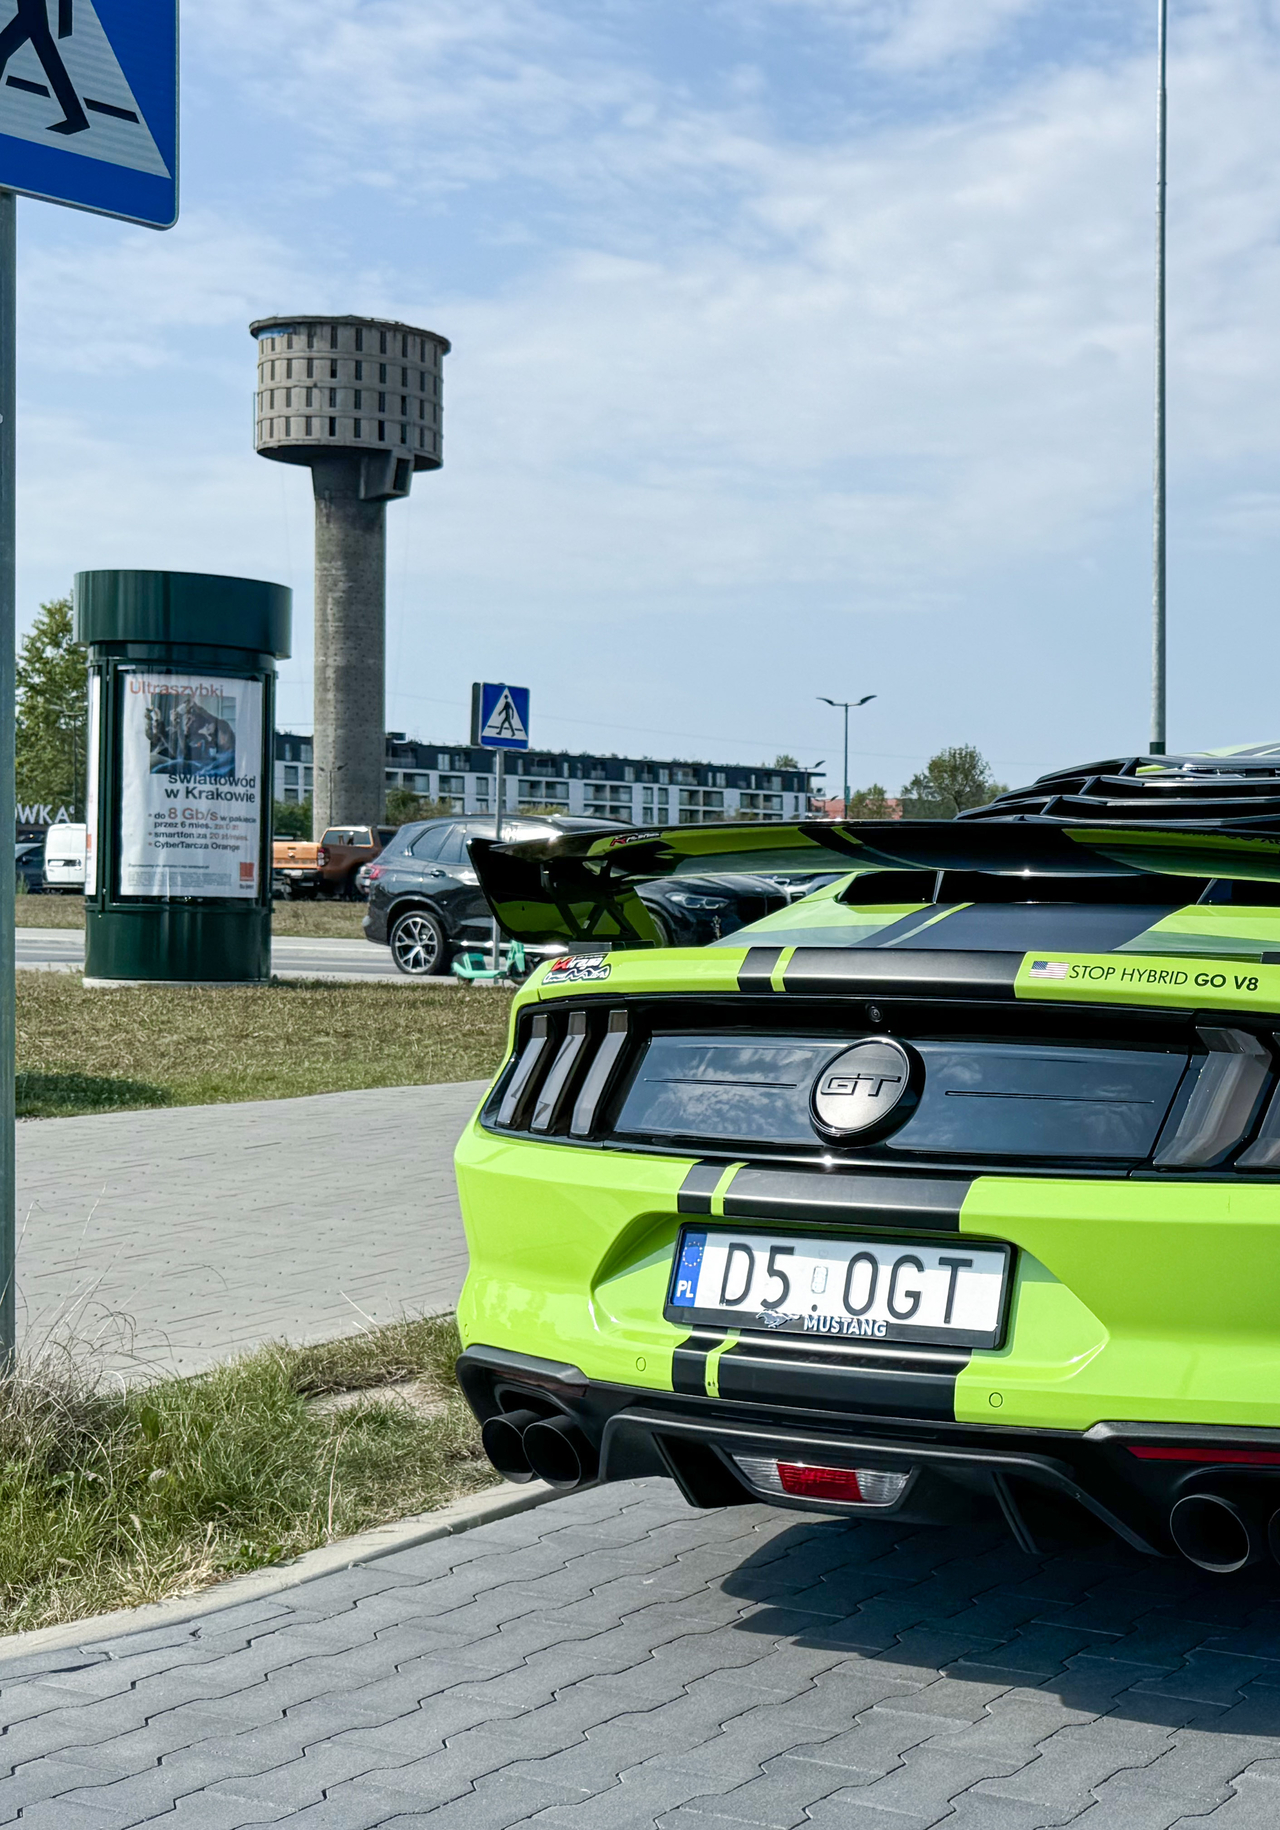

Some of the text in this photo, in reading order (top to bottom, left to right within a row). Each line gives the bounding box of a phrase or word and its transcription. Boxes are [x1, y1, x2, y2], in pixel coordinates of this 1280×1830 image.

[130, 680, 224, 699] Ultraszybki
[164, 786, 255, 803] w Krakowie
[154, 811, 166, 820] do
[168, 807, 178, 820] 8
[182, 807, 218, 822] Gb/s
[154, 821, 178, 829] przez
[180, 820, 187, 828] 6
[154, 831, 195, 840] smartfon
[196, 832, 207, 840] za
[154, 840, 241, 852] CyberTarcza Orange
[1069, 965, 1259, 991] STOP HYBRID GO V8
[820, 1073, 902, 1097] GT
[676, 1279, 695, 1298] PL
[803, 1315, 888, 1338] MUSTANG
